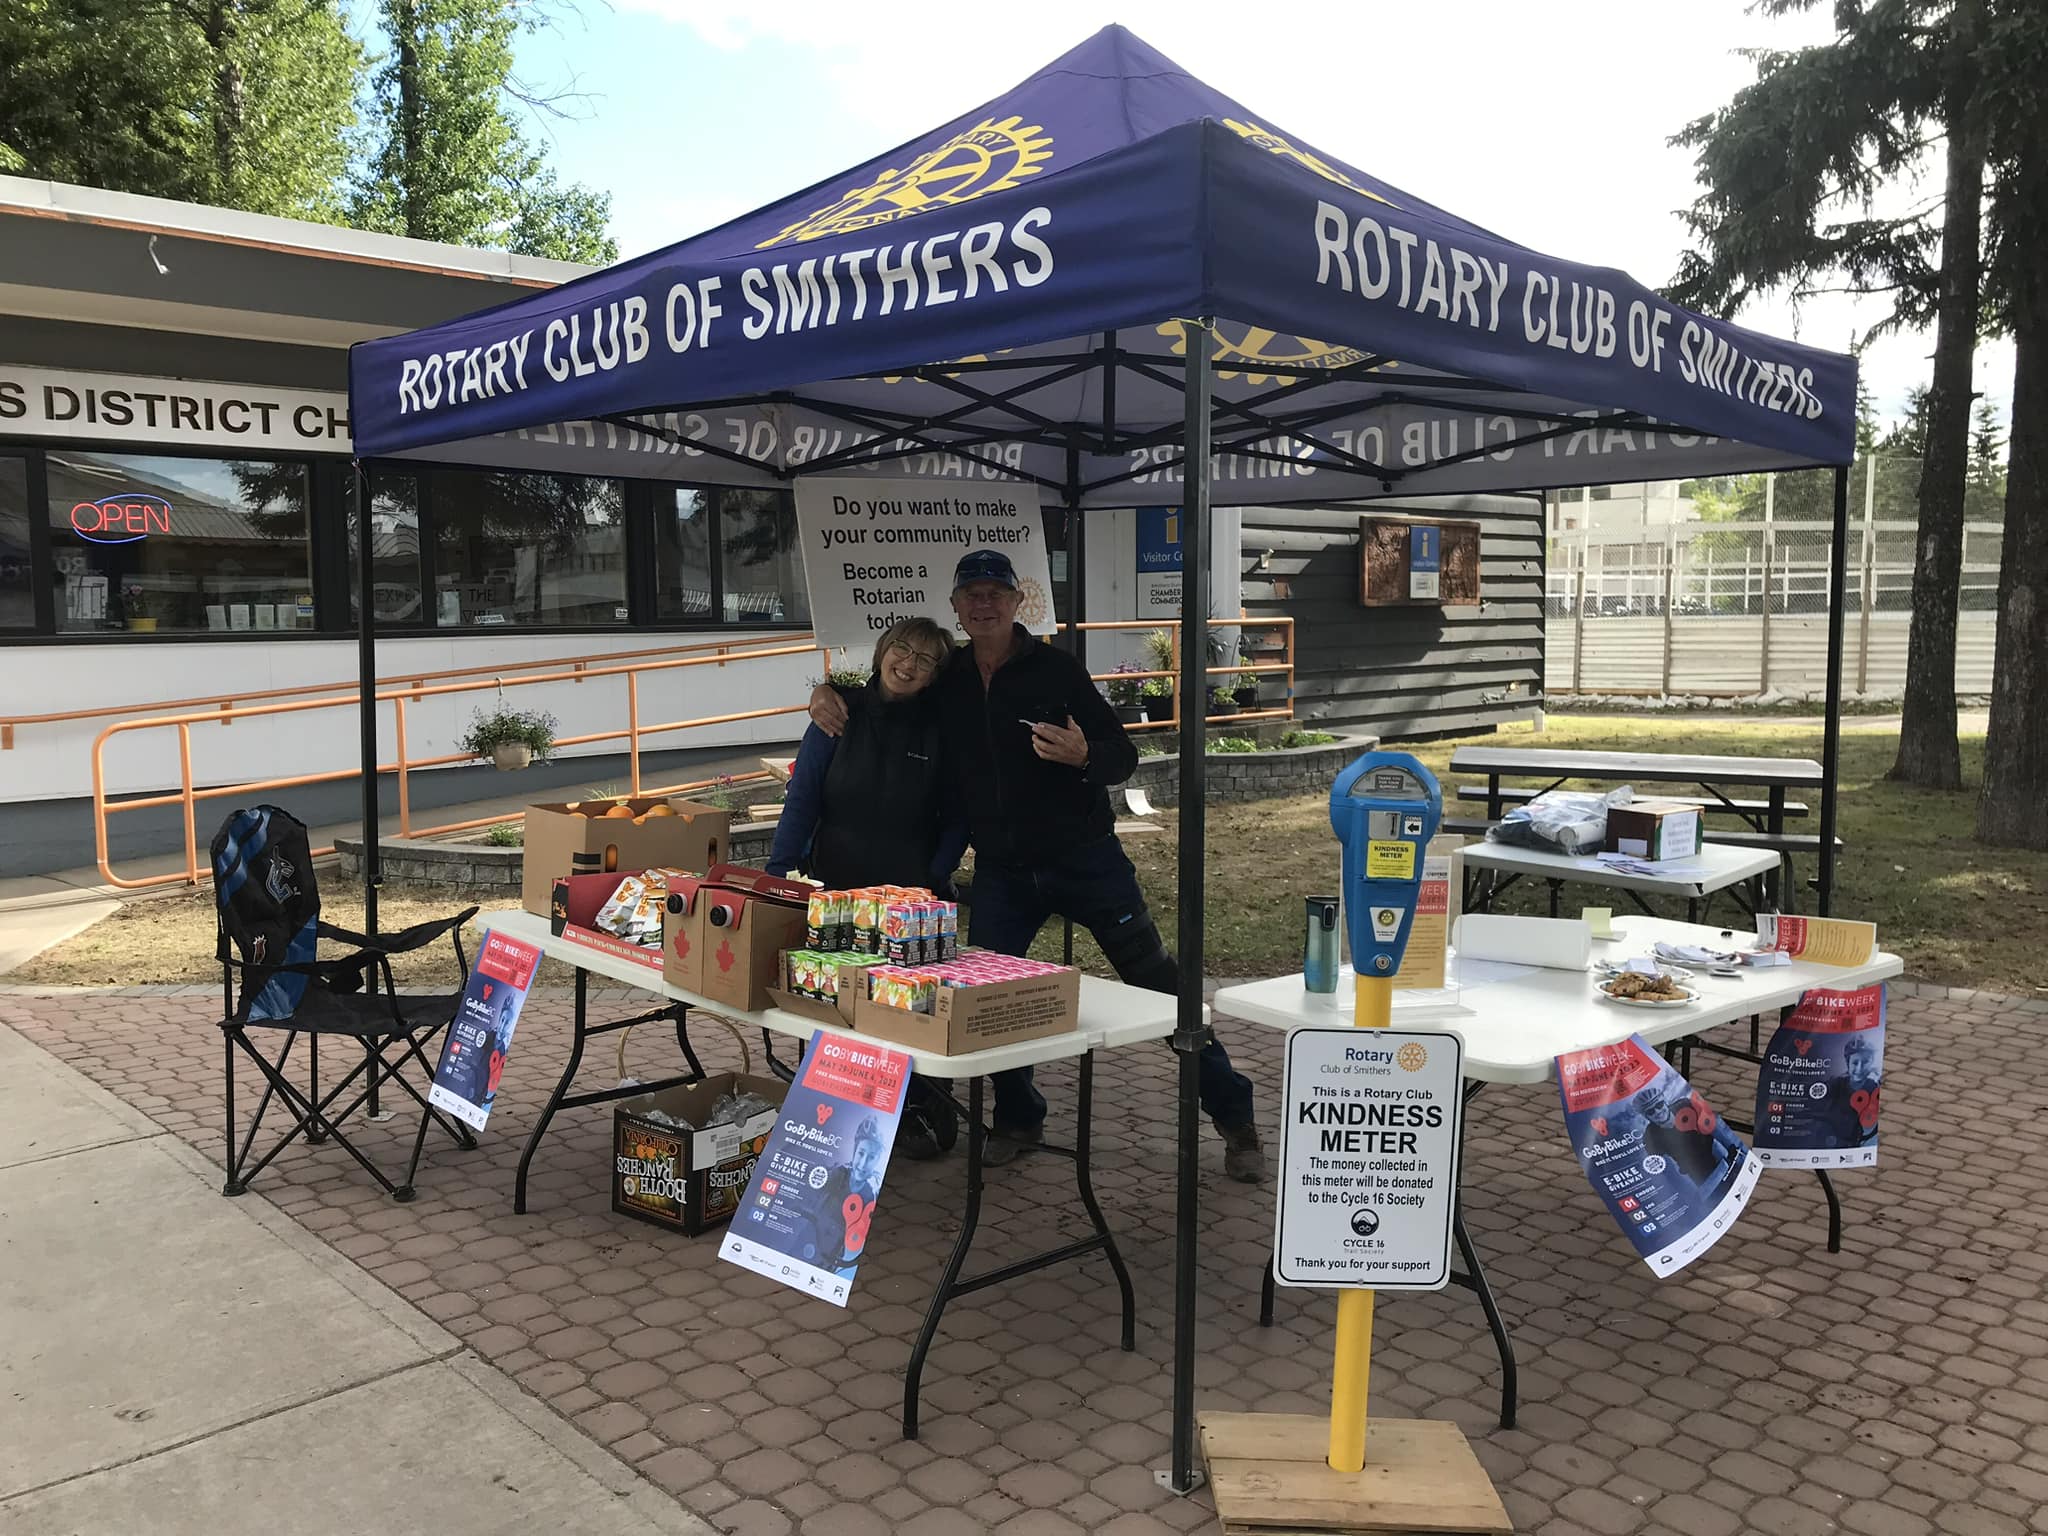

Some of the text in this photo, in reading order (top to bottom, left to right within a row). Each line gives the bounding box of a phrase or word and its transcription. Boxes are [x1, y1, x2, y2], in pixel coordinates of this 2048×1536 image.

[1314, 200, 1509, 334] ROTARY
[1522, 270, 1616, 359] CLUB
[1628, 300, 1672, 373] OF
[400, 207, 1053, 414] ROTARY CLUB OF SMITHERS
[43, 385, 280, 435] DISTRICT
[833, 496, 1017, 520] Do you want to make
[71, 503, 170, 532] OPEN
[821, 524, 1031, 549] your community better?
[1143, 551, 1171, 562] Visitor
[843, 562, 928, 580] Become a
[853, 587, 925, 605] Rotarian
[1374, 845, 1409, 853] KINDNESS
[1345, 1047, 1394, 1064] Rotary
[1769, 1054, 1831, 1070] GoByBikeBC
[1320, 1064, 1391, 1075] Club of Smithers
[1312, 1086, 1433, 1101] This is a Rotary Club
[1769, 1089, 1805, 1097] GIVEAWAY
[1770, 1081, 1805, 1091] E-BIKE
[1299, 1102, 1443, 1128] KINDNESS
[1771, 1115, 1782, 1123] 02
[784, 1119, 842, 1149] GoByBikeBC
[1320, 1129, 1418, 1154] METER
[1582, 1129, 1644, 1159] GoByBikeBC
[617, 1156, 675, 1184] RANCHES
[773, 1153, 808, 1172] E-BIKE
[1310, 1156, 1428, 1173] The money collected in
[1302, 1174, 1434, 1189] this meter will be donated
[1603, 1166, 1640, 1186] E-BIKE
[1608, 1173, 1644, 1192] GIVEAWAY
[640, 1177, 687, 1204] BOOTH
[766, 1182, 777, 1192] 01
[759, 1196, 771, 1207] 02
[1308, 1191, 1425, 1208] to the Cycle 16 Society
[1624, 1198, 1637, 1209] 01
[752, 1210, 765, 1221] 03
[1633, 1210, 1647, 1221] 02
[1643, 1222, 1657, 1233] 03
[1343, 1239, 1385, 1248] CYCLE 16
[1295, 1257, 1430, 1272] Thank you for your support
